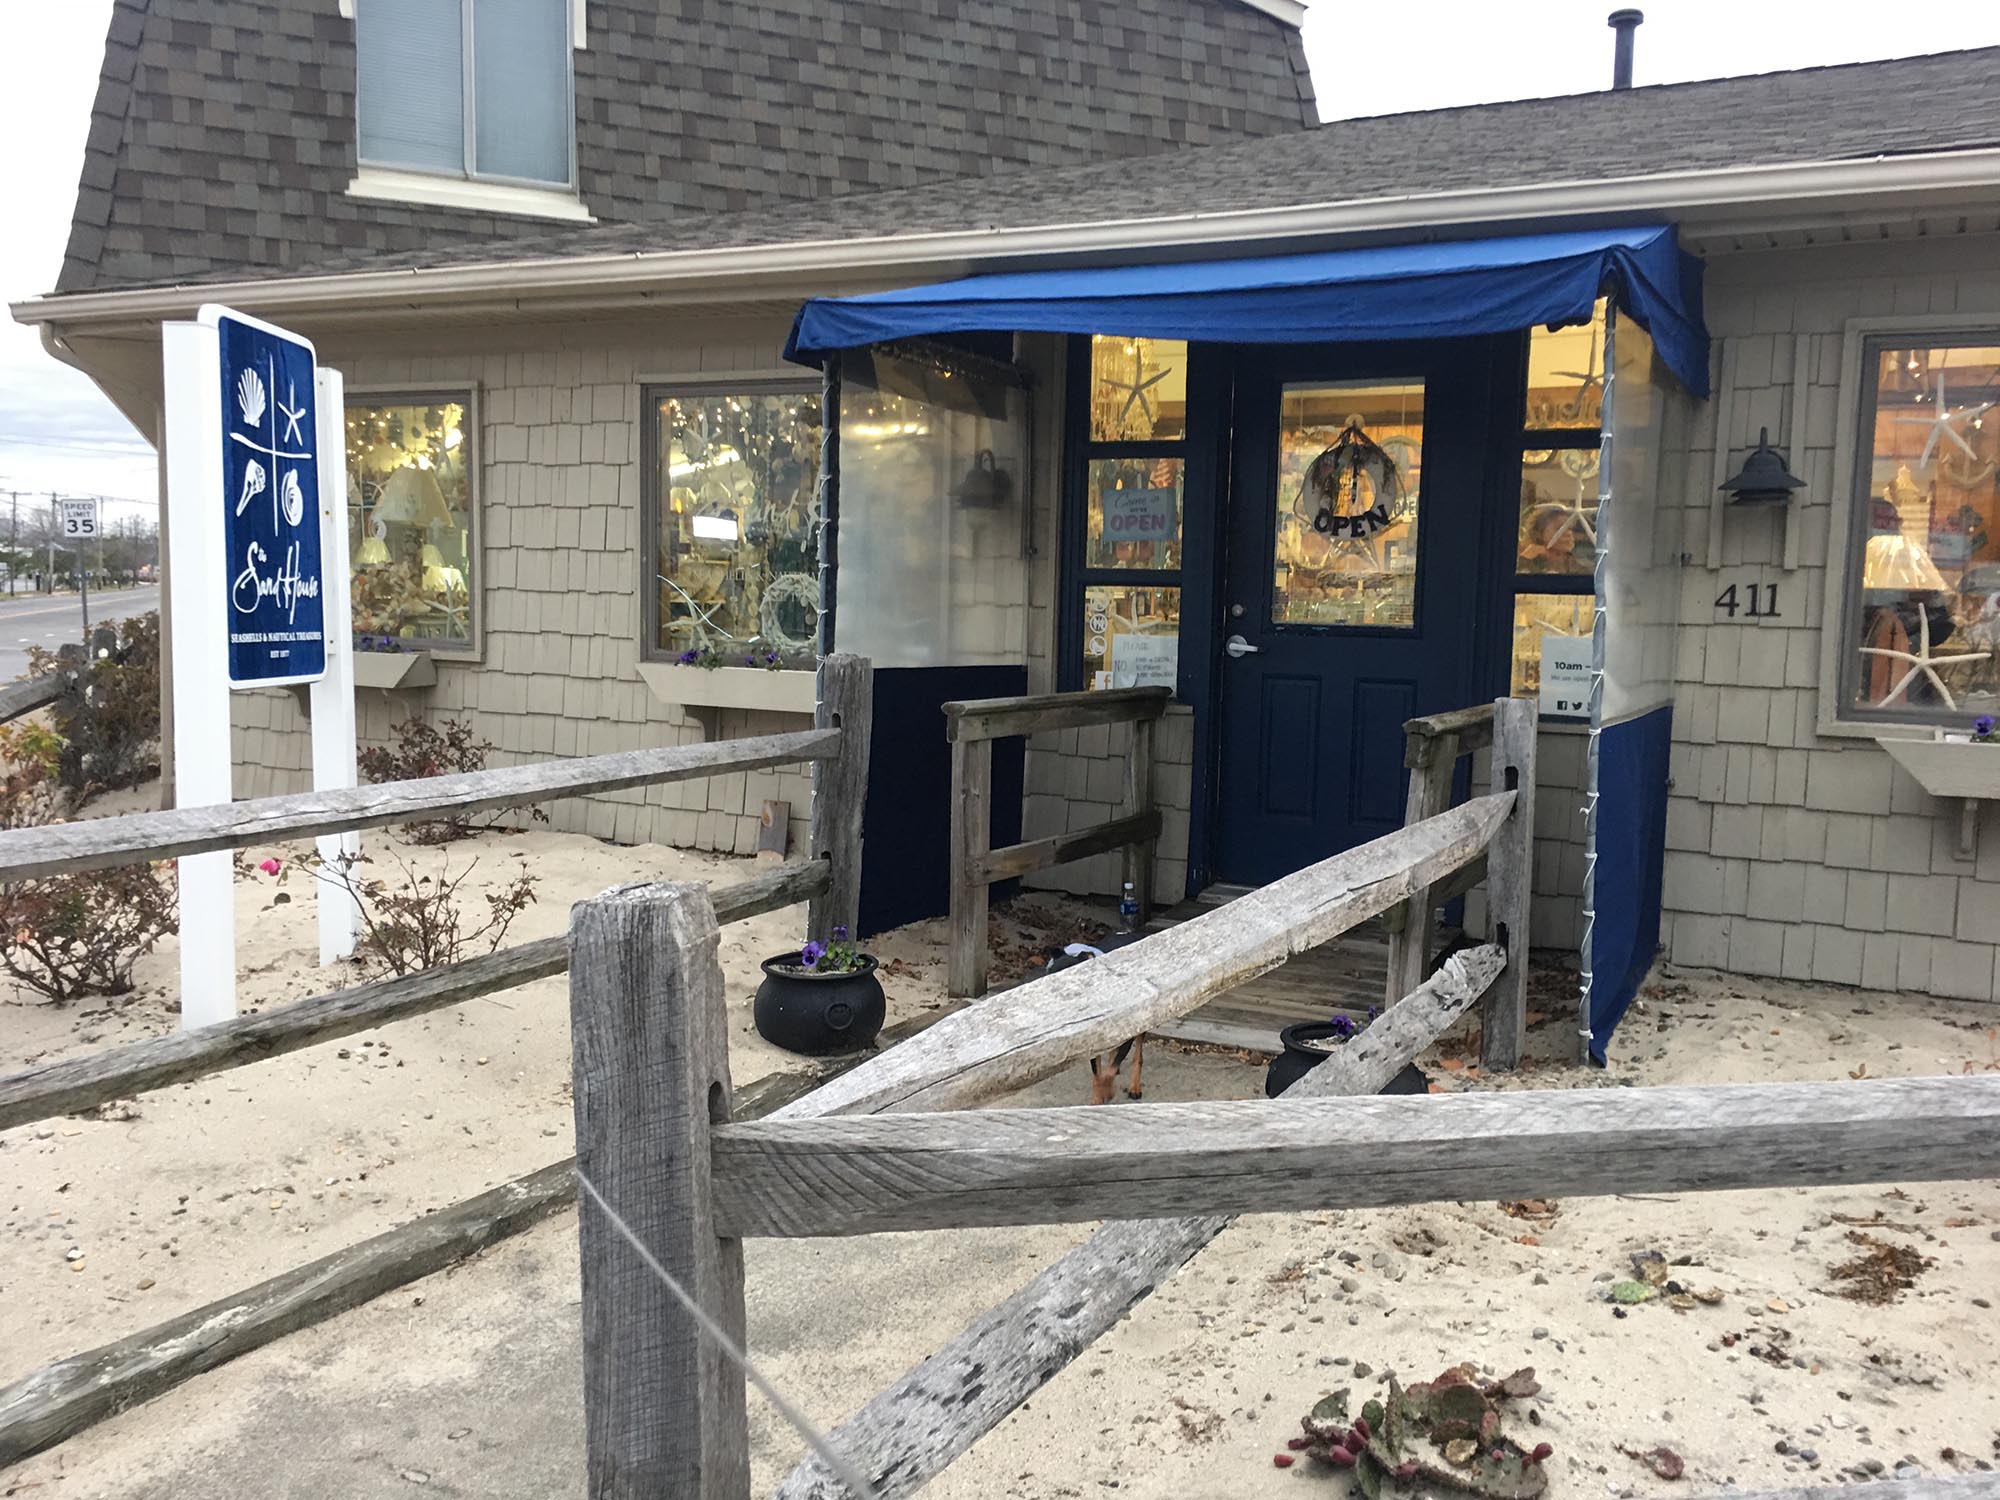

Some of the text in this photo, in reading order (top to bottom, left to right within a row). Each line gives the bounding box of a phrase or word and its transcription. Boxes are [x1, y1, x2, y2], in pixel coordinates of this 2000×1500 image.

[67, 519, 94, 533] 35
[1110, 513, 1166, 532] OPEN
[1313, 503, 1390, 538] OPEN
[232, 540, 318, 625] Sand House
[1714, 583, 1782, 617] 411
[231, 633, 262, 643] SEASHELLS
[268, 632, 297, 642] NAUTICAL
[1114, 659, 1128, 672] NO
[1554, 661, 1583, 671] 10am
